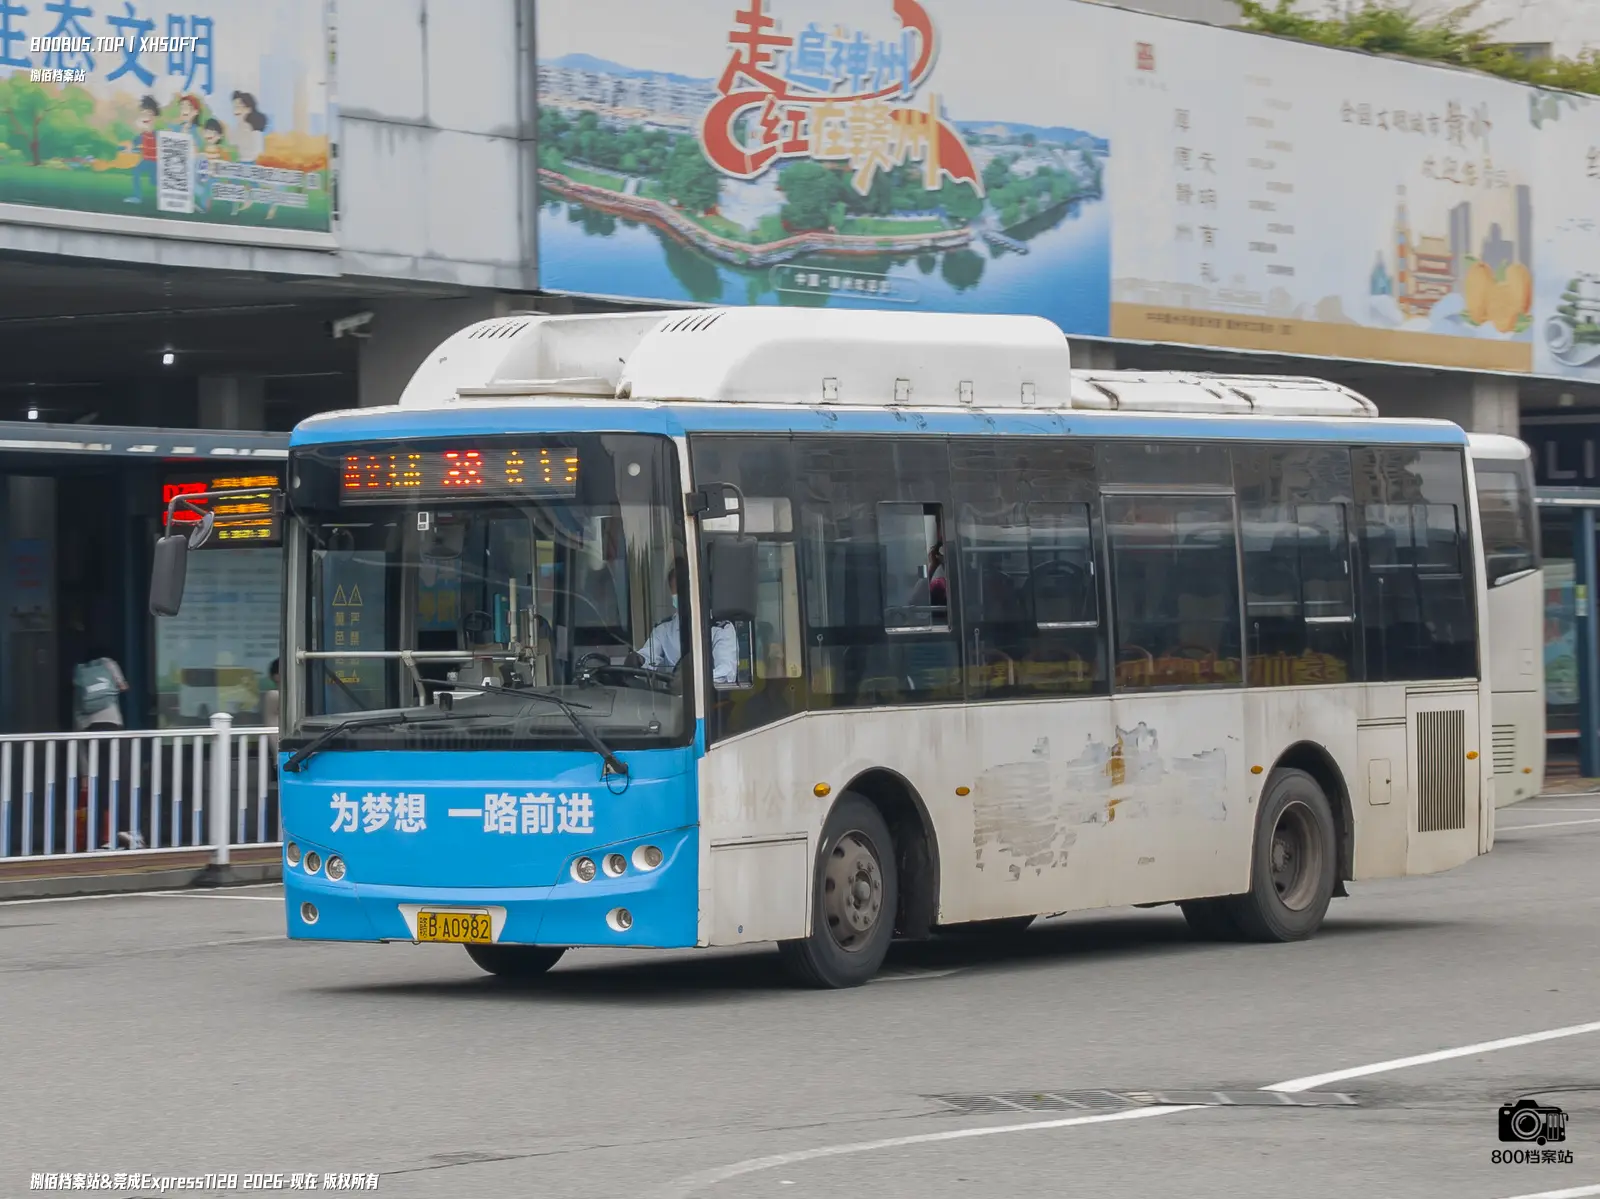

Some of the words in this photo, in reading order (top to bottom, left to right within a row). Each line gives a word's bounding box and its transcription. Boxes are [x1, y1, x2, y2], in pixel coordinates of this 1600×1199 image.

[330, 792, 426, 834] 为梦想
[448, 792, 594, 835] 一路前进
